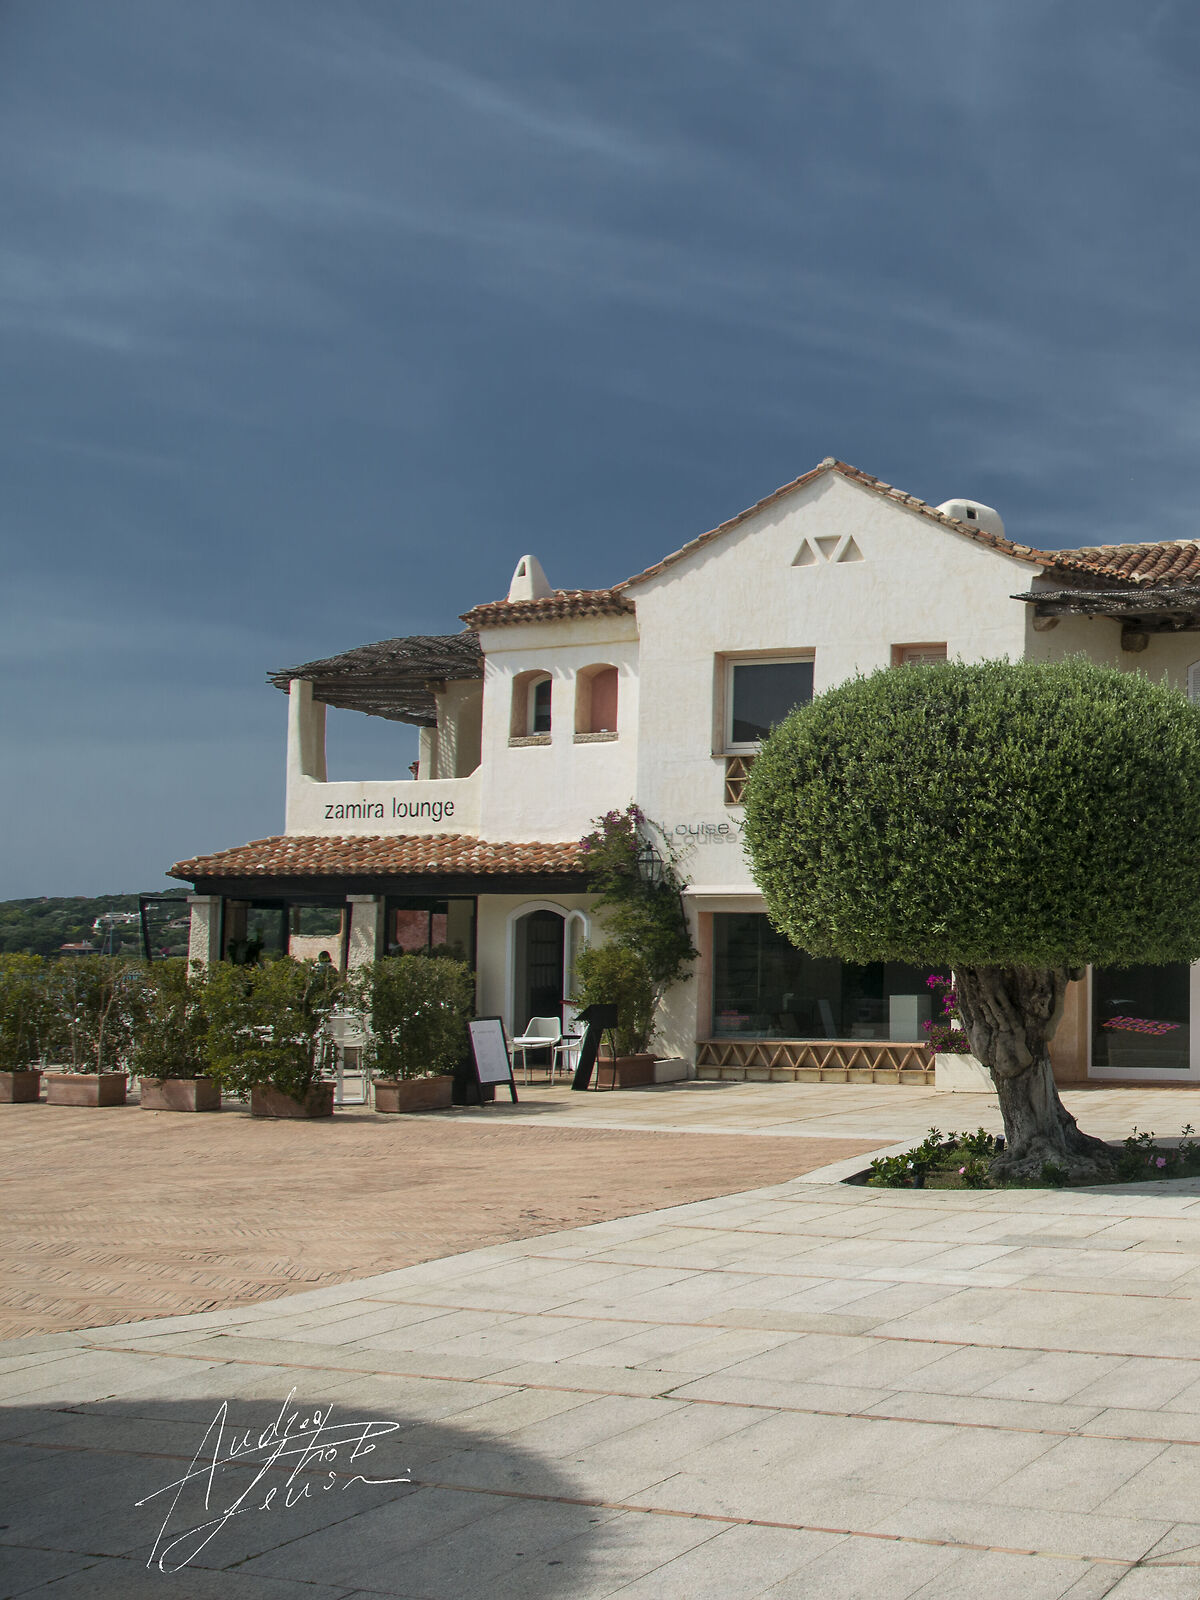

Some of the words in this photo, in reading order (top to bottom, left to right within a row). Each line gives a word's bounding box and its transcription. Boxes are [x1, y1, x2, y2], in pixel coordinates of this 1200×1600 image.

[325, 799, 384, 819] zamira
[392, 797, 455, 823] lounge
[662, 821, 730, 835] Louise
